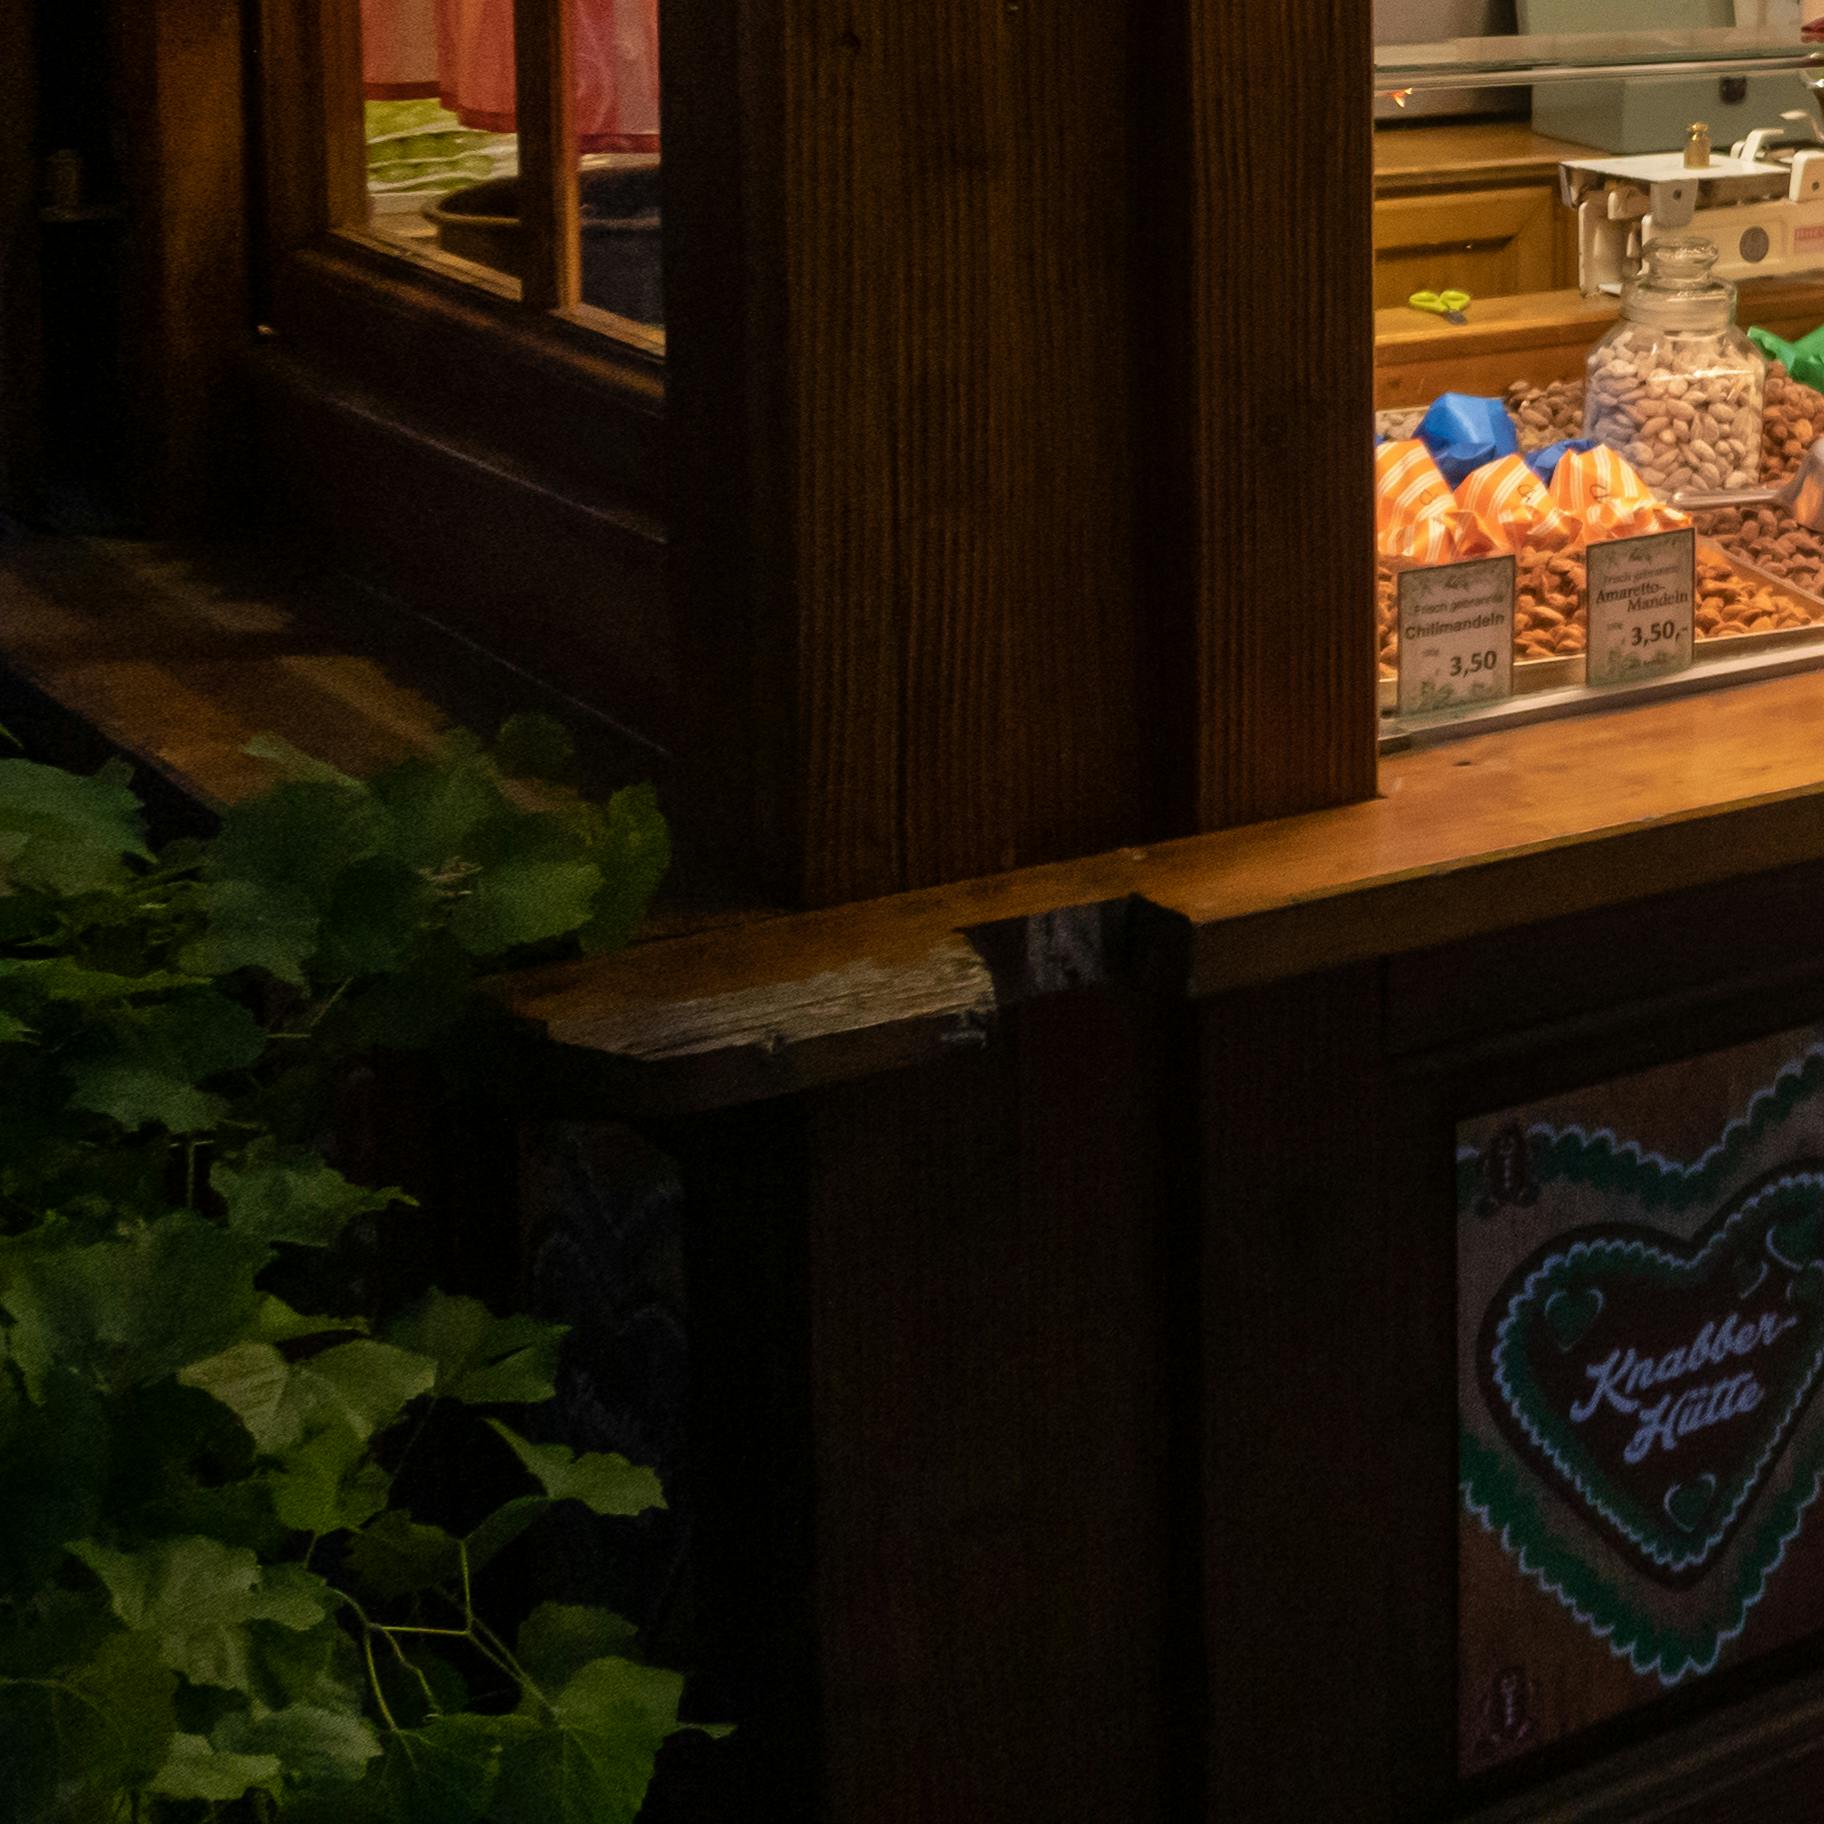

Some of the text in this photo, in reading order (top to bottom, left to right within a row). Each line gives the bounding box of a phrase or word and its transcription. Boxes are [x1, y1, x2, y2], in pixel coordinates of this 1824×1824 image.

[1596, 582, 1665, 604] Amaretto-
[1627, 590, 1688, 613] Mandeln
[1450, 650, 1498, 678] 3,50
[1569, 1312, 1798, 1423] Knabber-
[1623, 1371, 1765, 1465] Hütte
